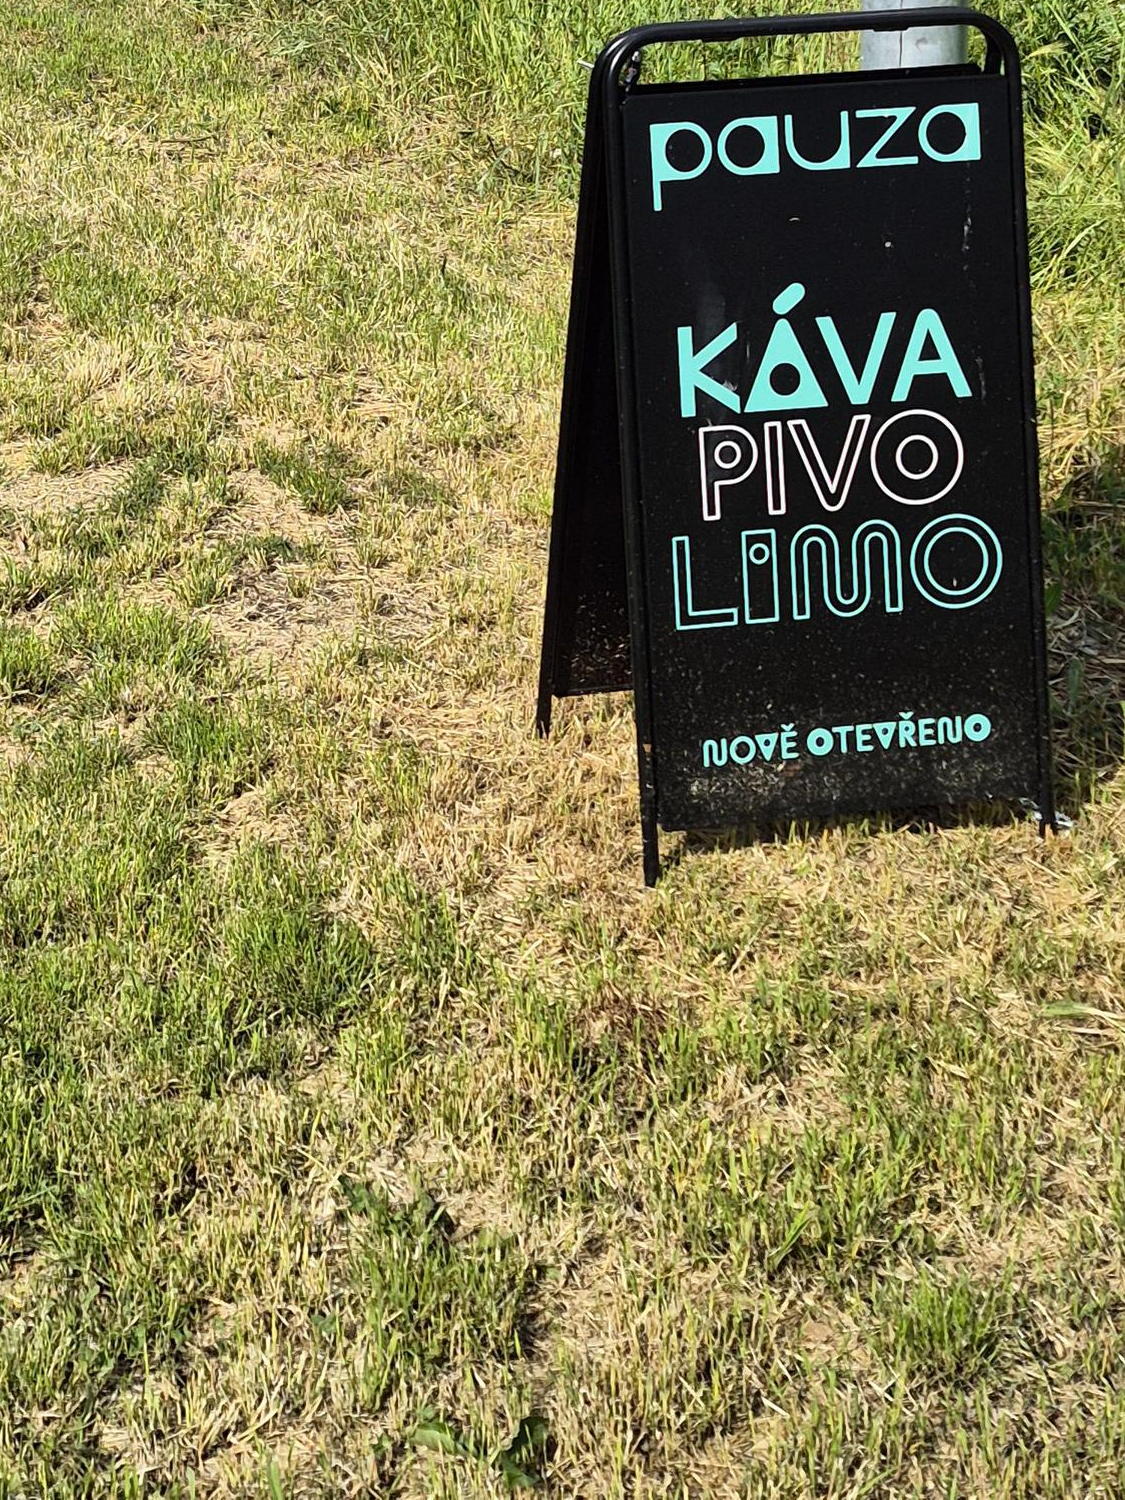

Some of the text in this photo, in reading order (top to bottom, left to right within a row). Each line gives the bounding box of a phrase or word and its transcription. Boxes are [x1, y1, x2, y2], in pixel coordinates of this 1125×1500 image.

[649, 102, 982, 212] pauza
[676, 282, 973, 418] KÁVA
[698, 409, 964, 522] PIVO
[672, 513, 1003, 631] LIMO
[702, 711, 992, 768] NOVĚ OTEVŘENO
